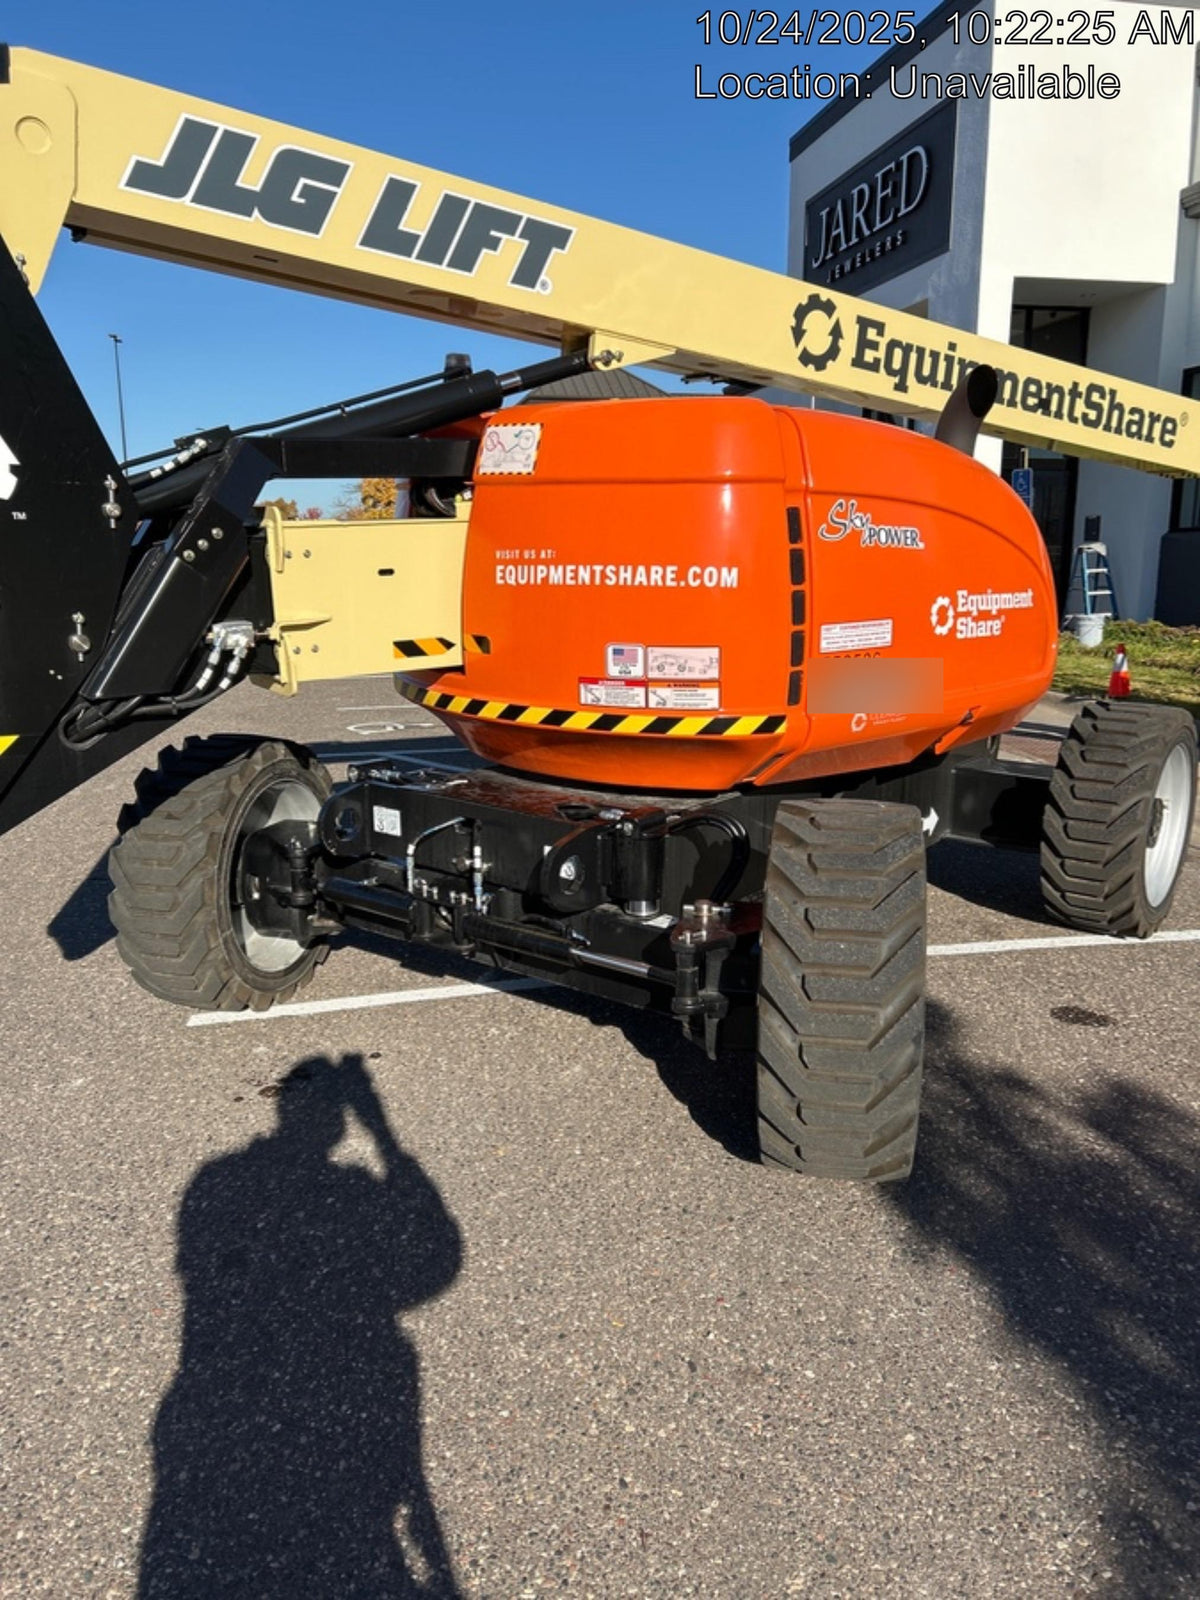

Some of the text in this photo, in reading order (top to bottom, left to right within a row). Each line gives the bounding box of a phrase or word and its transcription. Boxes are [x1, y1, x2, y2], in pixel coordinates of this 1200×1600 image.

[119, 113, 354, 238] JLG
[812, 144, 930, 269] JARED
[825, 229, 904, 283] JEWELERS
[495, 549, 557, 559] VISIT US AT:
[495, 564, 739, 588] EQUIPMENTSHARE.COM
[956, 588, 1034, 616] Equipment
